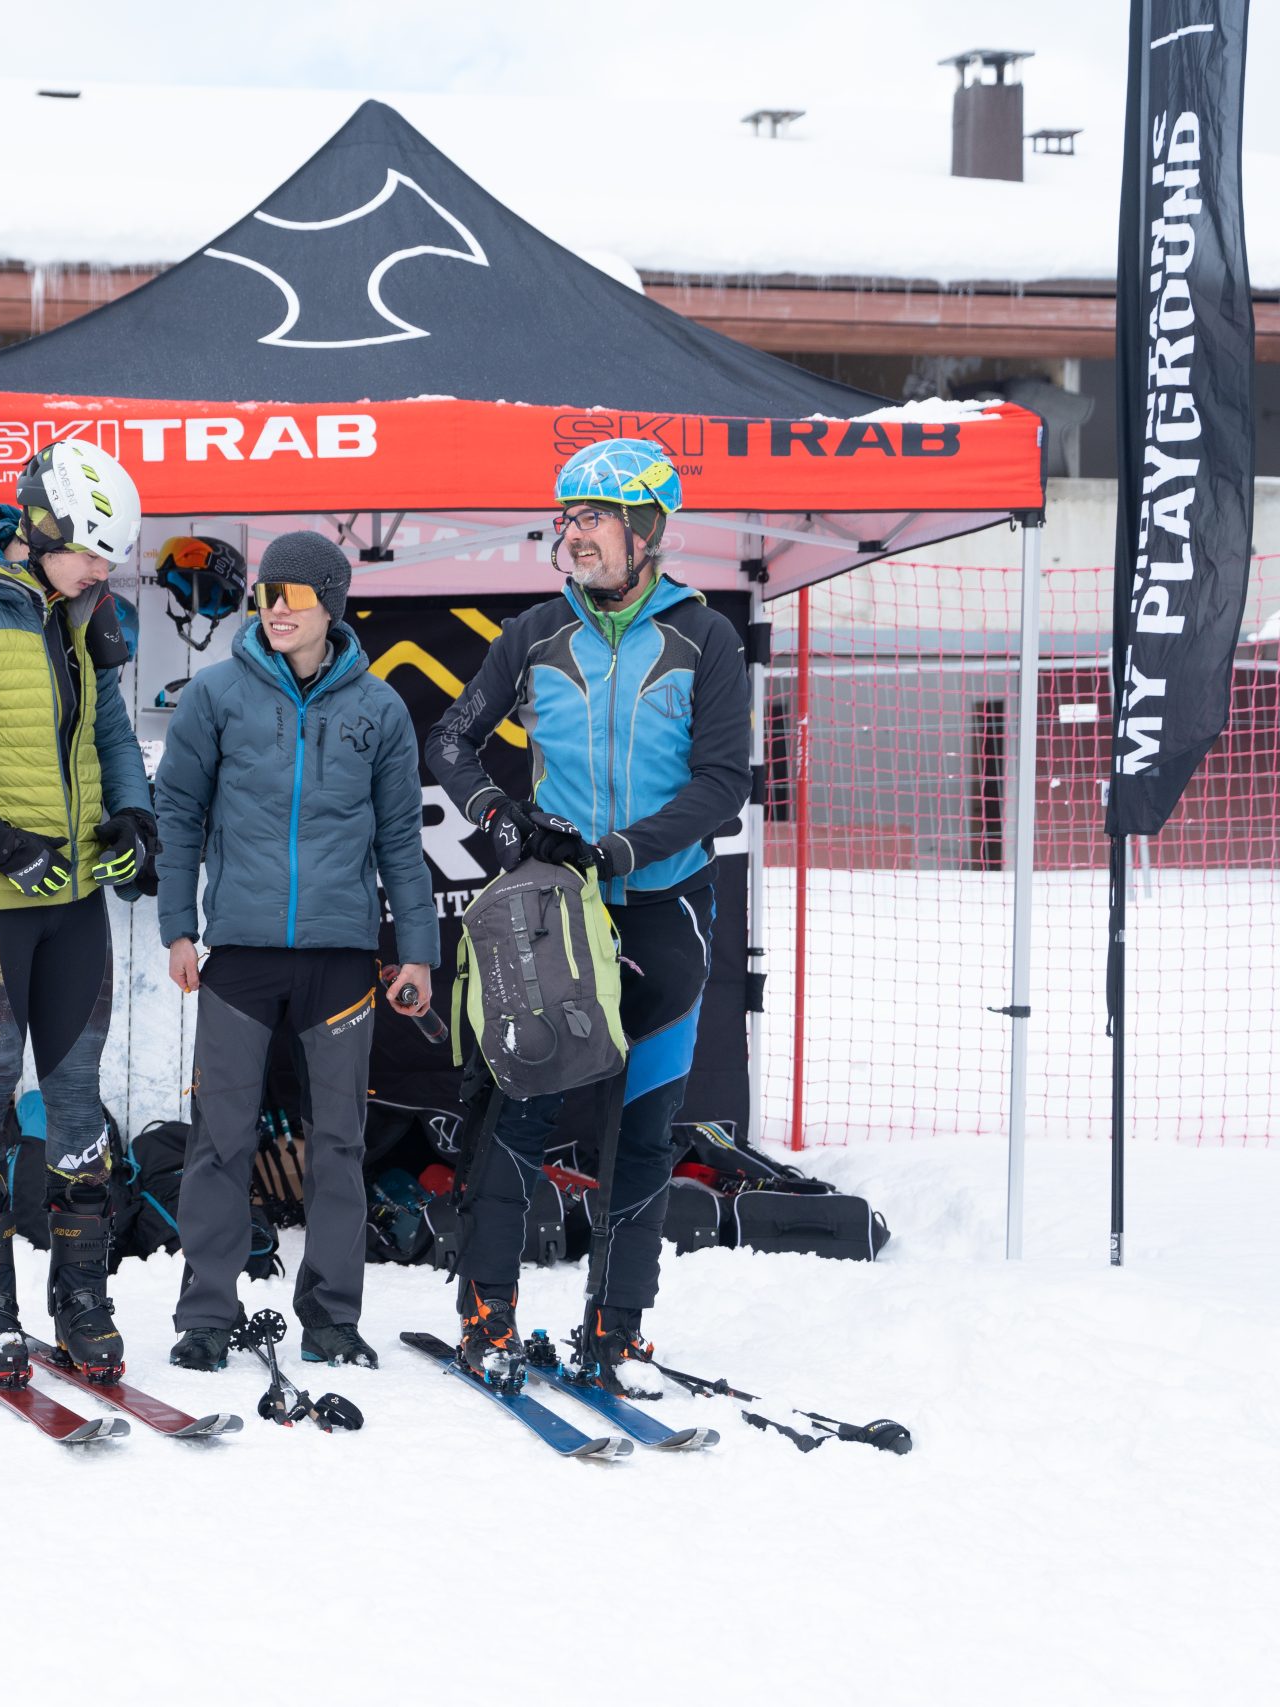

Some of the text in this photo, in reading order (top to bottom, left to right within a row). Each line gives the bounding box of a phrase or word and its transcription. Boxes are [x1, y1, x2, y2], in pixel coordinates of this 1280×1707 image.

[1136, 110, 1203, 635] PLAYGROUND
[1122, 664, 1166, 776] MY
[23, 857, 45, 877] CAMP
